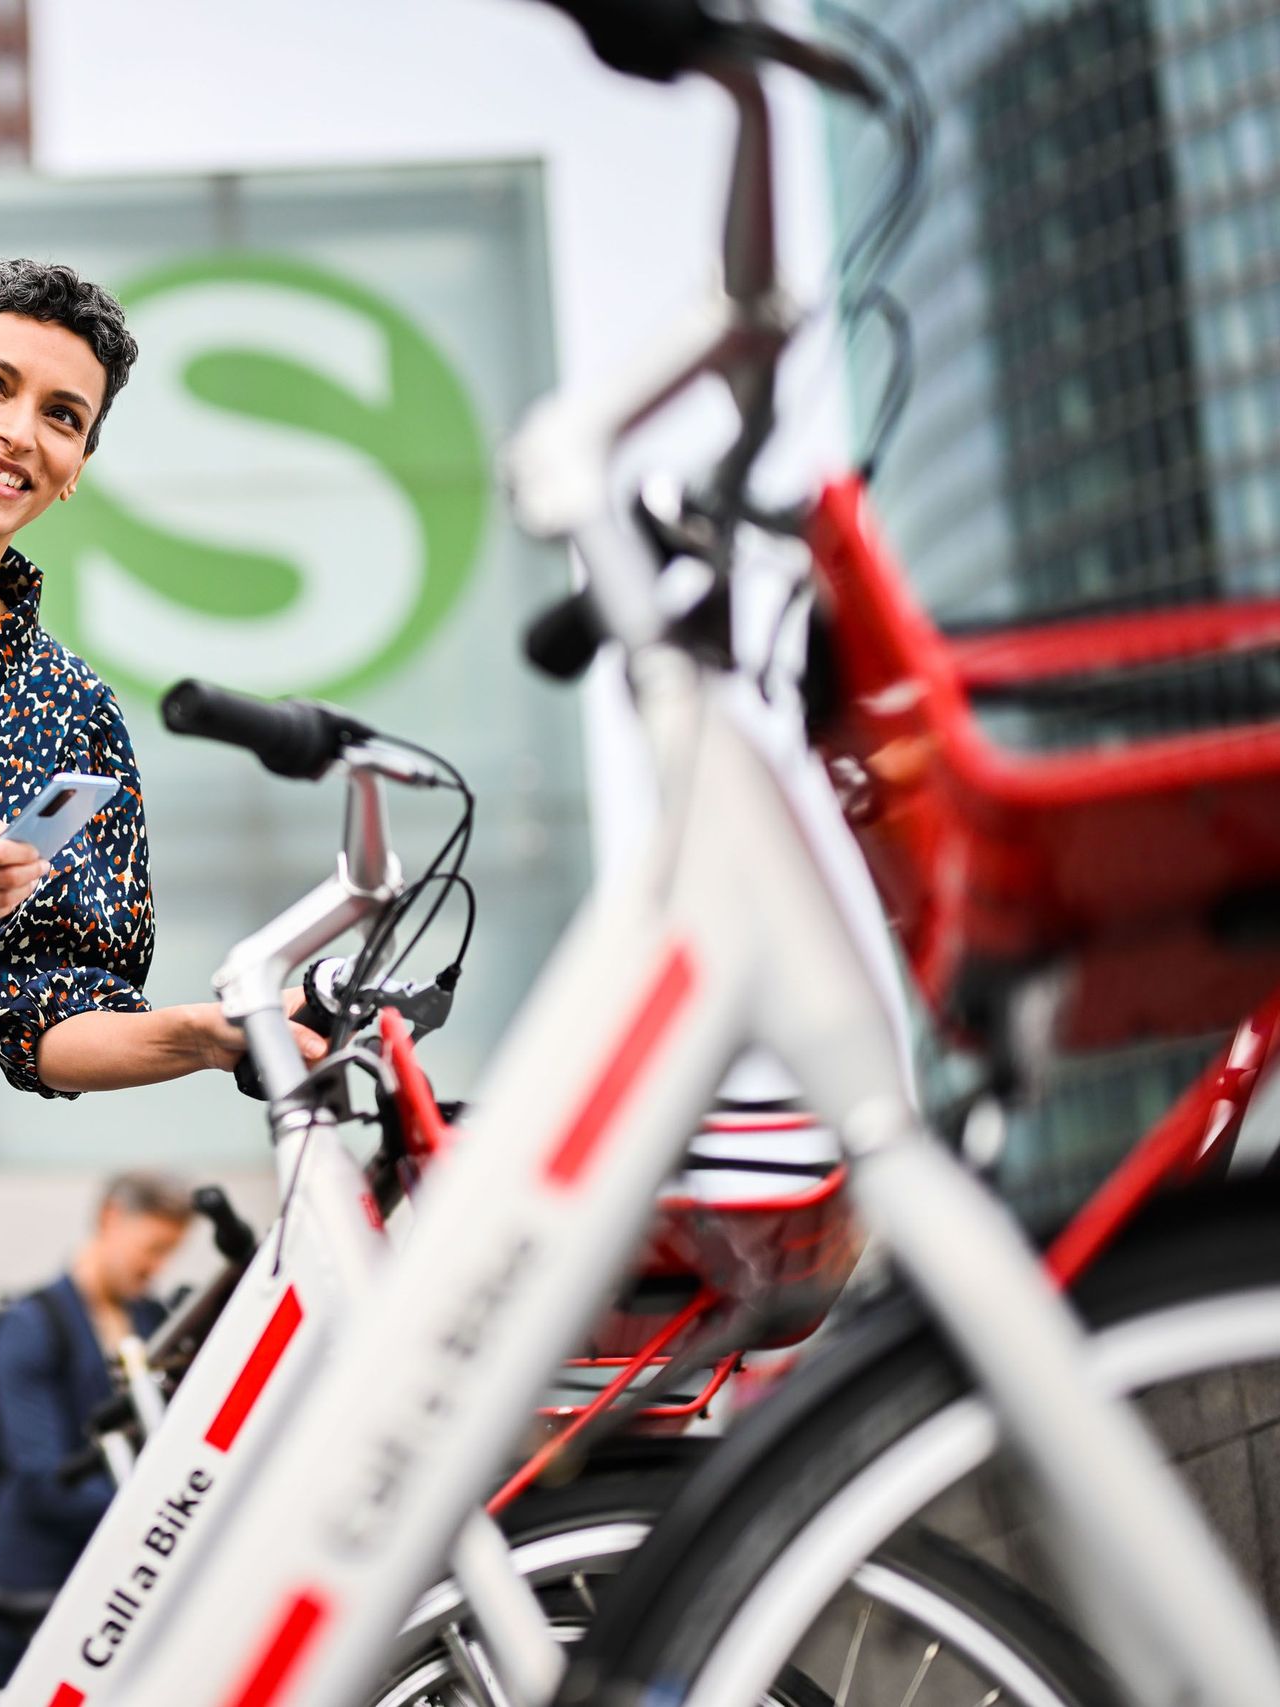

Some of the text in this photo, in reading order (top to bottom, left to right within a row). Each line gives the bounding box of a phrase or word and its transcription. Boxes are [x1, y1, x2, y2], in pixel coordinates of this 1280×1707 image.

[74, 280, 426, 694] S
[81, 1469, 214, 1668] Call a Bike
